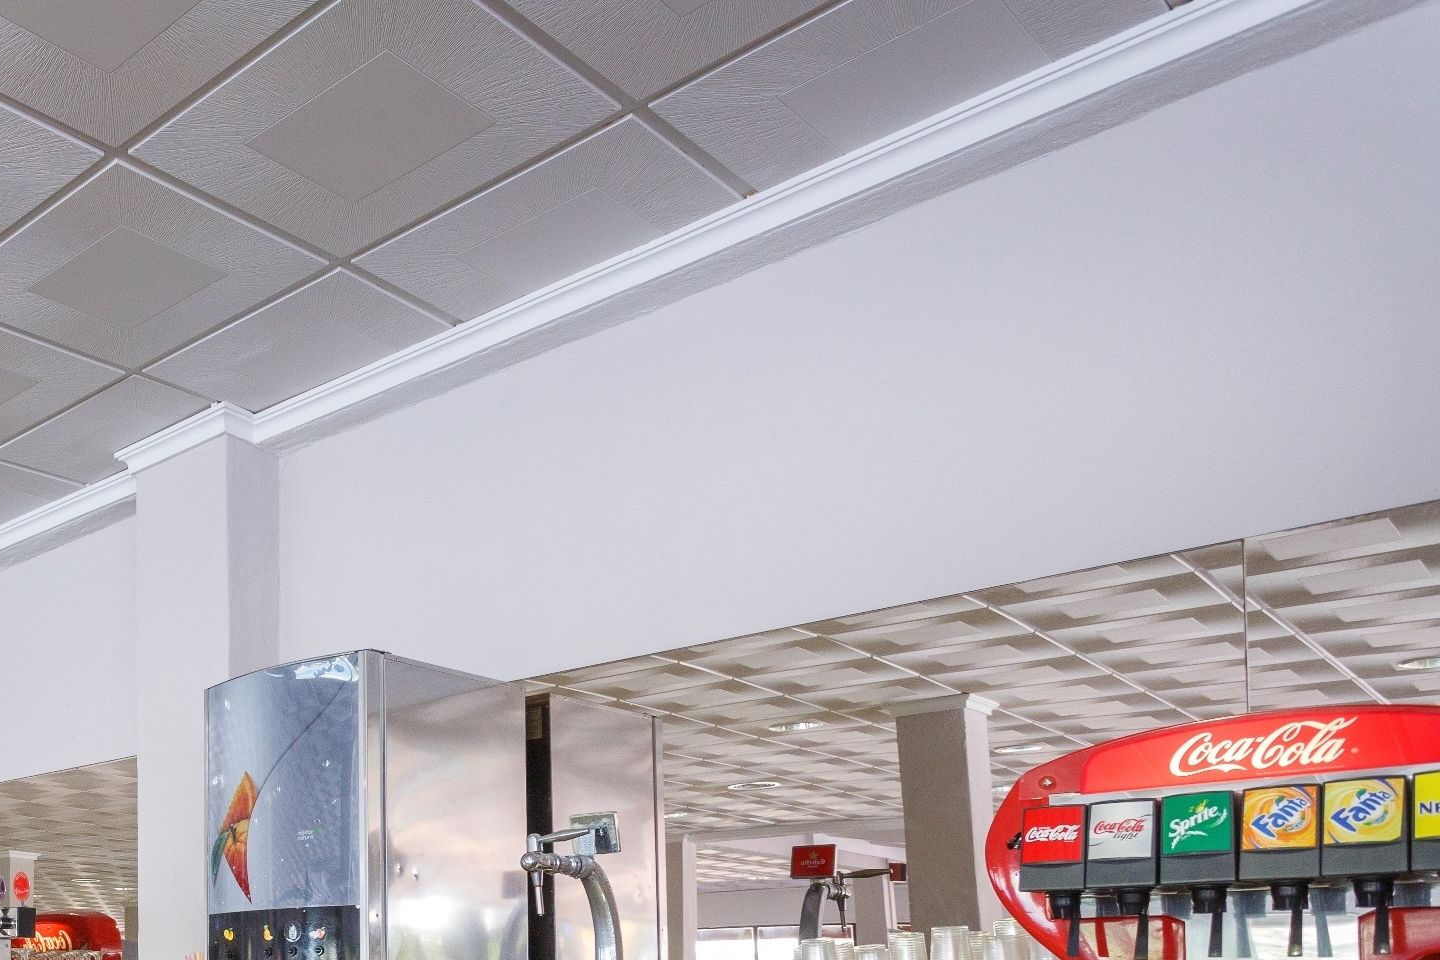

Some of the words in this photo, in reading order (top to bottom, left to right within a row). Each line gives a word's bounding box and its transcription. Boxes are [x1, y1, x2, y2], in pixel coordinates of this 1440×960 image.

[1169, 716, 1359, 777] Coca-Cola
[1094, 818, 1146, 834] Coca-Cola
[1168, 805, 1219, 838] Sprite
[1250, 797, 1308, 838] Fanta
[1329, 791, 1391, 832] Fanta
[1025, 824, 1081, 842] Coca-Cola
[1114, 831, 1139, 840] light
